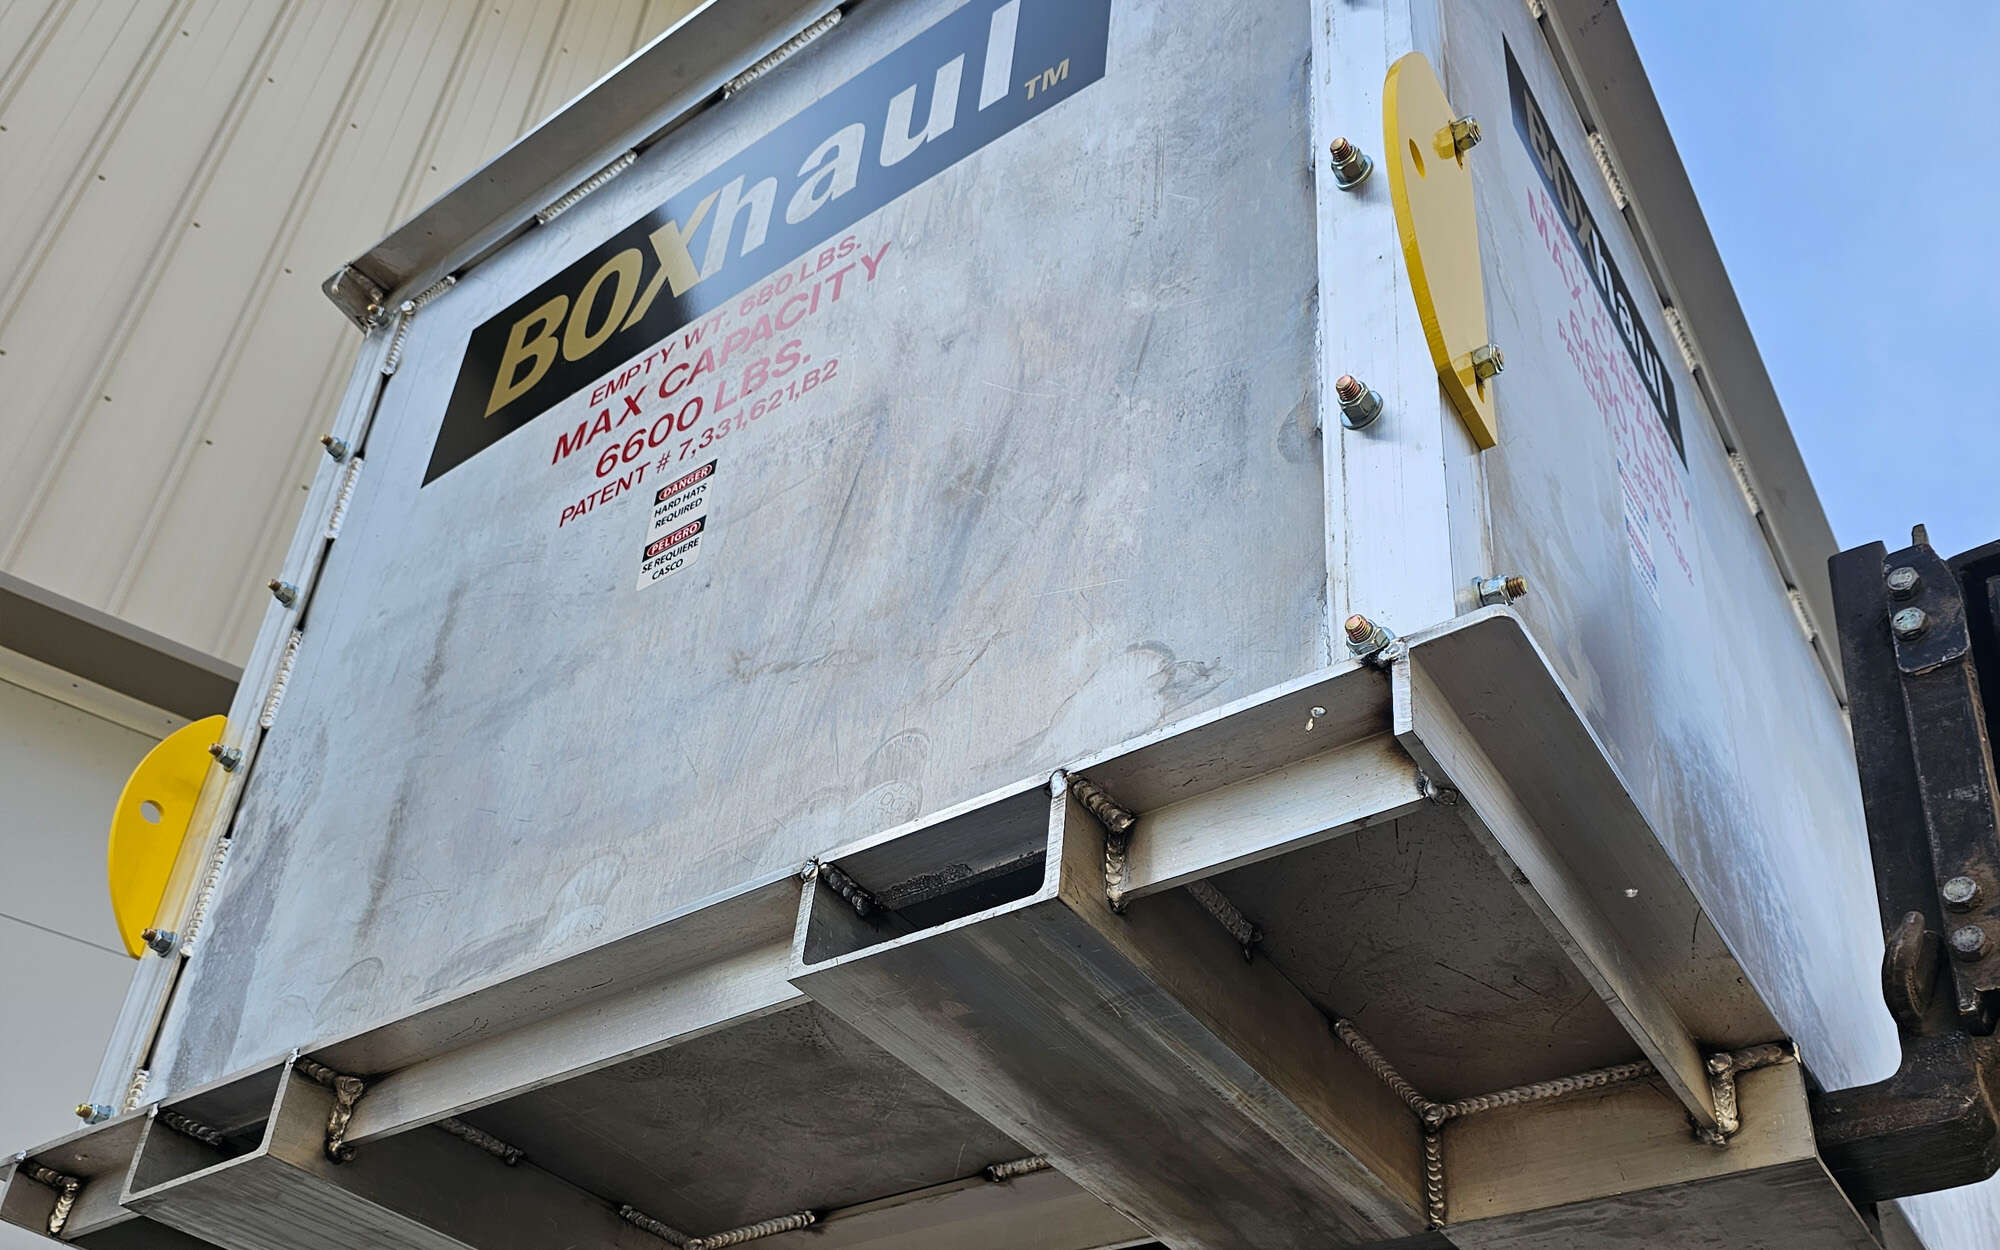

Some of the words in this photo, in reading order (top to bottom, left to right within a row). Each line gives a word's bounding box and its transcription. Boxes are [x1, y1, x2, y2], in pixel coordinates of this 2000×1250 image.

[485, 0, 1021, 418] BOXhaul
[1024, 58, 1069, 100] TM
[589, 341, 676, 408] EMPTY
[684, 310, 731, 350] WT.
[739, 272, 793, 317] 680
[800, 235, 862, 283] LBS.
[552, 385, 647, 465] MAX
[658, 241, 891, 399] CAPACITY
[595, 396, 703, 478] 6600
[713, 340, 811, 415] LBS.
[559, 462, 651, 528] PATENT
[656, 450, 671, 474] #
[654, 497, 681, 518] HARD
[682, 483, 708, 502] HATS
[662, 466, 711, 498] DANGER
[655, 497, 703, 529] REQUIRED
[641, 562, 653, 574] SE
[654, 537, 700, 567] REQUIERE
[651, 522, 699, 554] PELIGRO
[652, 559, 684, 580] CASCO
